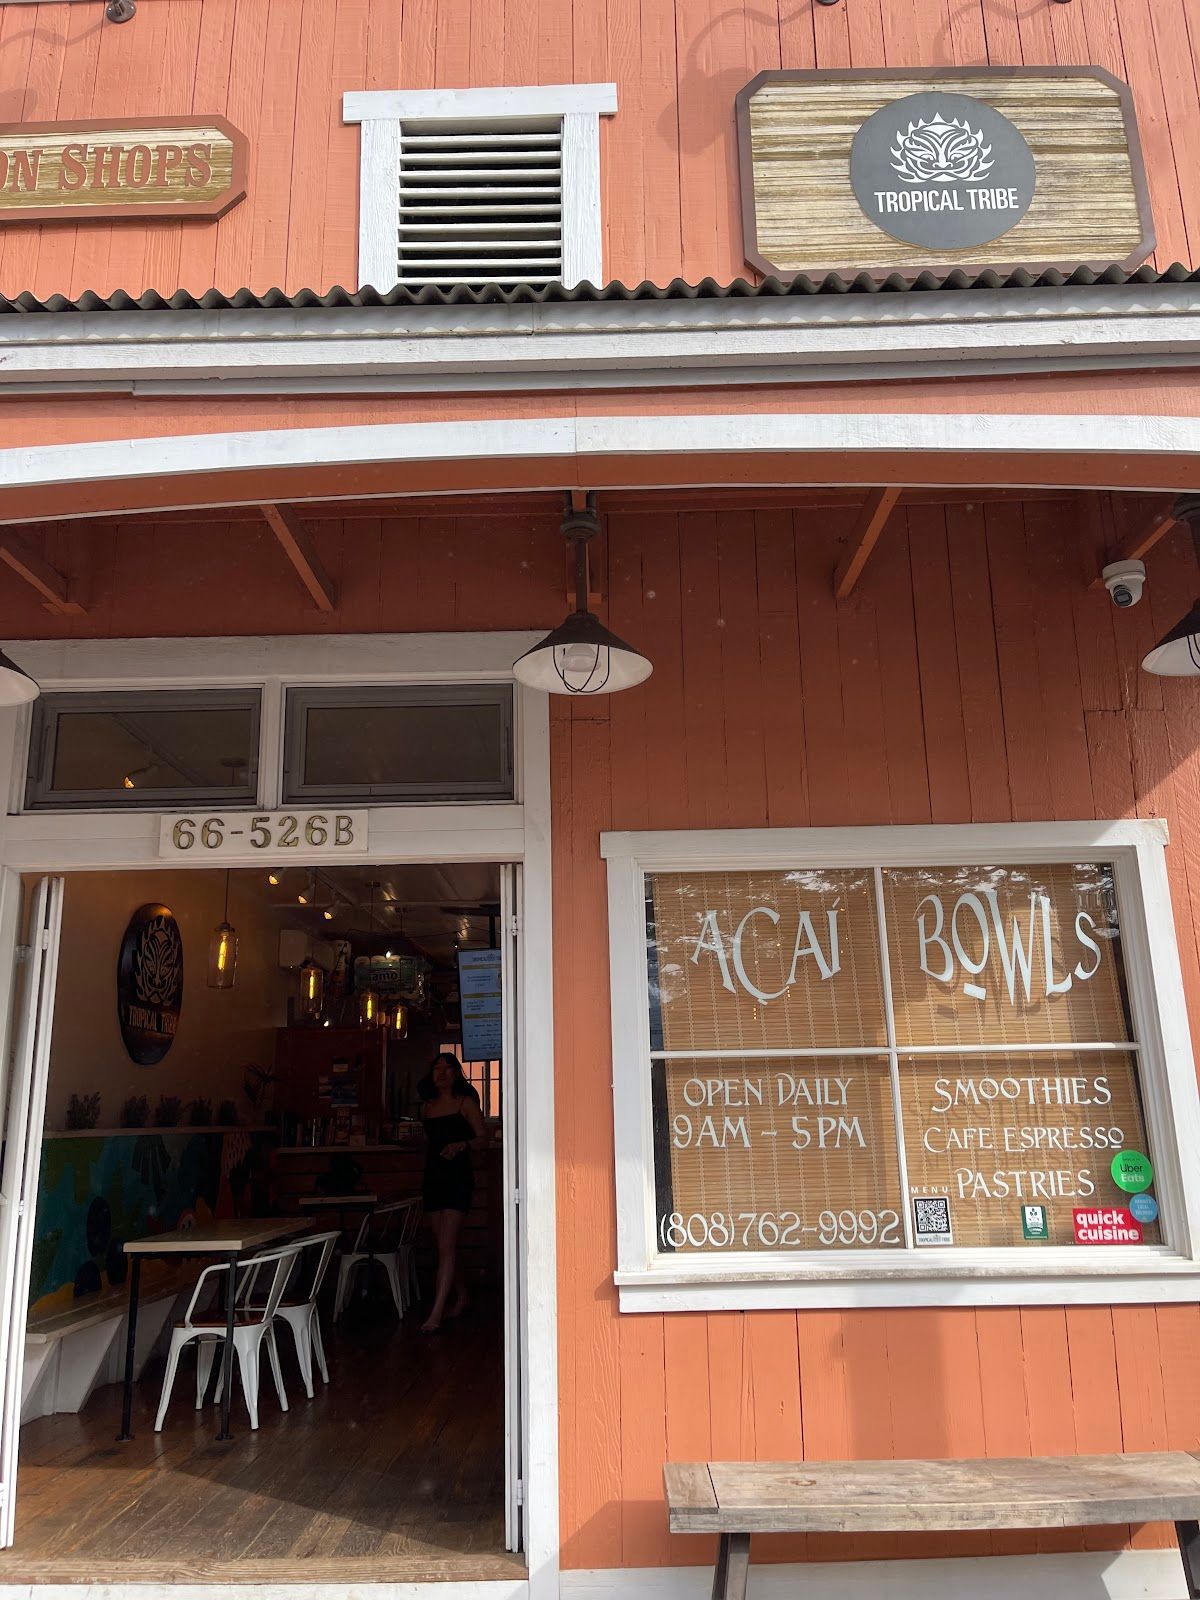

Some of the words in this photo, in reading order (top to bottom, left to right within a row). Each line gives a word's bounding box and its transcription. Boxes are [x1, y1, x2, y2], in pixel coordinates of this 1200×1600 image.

[58, 143, 212, 190] SHOPS
[874, 189, 964, 213] TROPICAL
[966, 187, 1019, 210] TRIBE
[172, 815, 354, 850] 66-526B
[913, 890, 1101, 1006] BOWLS
[683, 1078, 763, 1107] OPEN
[775, 1073, 853, 1105] DAILY
[932, 1076, 1112, 1112] SMOOTHIES
[924, 1127, 993, 1153] CAFE
[1003, 1127, 1124, 1152] ESPRESSO
[1120, 1164, 1143, 1173] Uber
[1121, 1173, 1145, 1183] Eats
[910, 1186, 949, 1194] MENU
[954, 1168, 1095, 1199] PASTRIES
[1076, 1210, 1125, 1226] quick
[1077, 1226, 1140, 1241] cuisine
